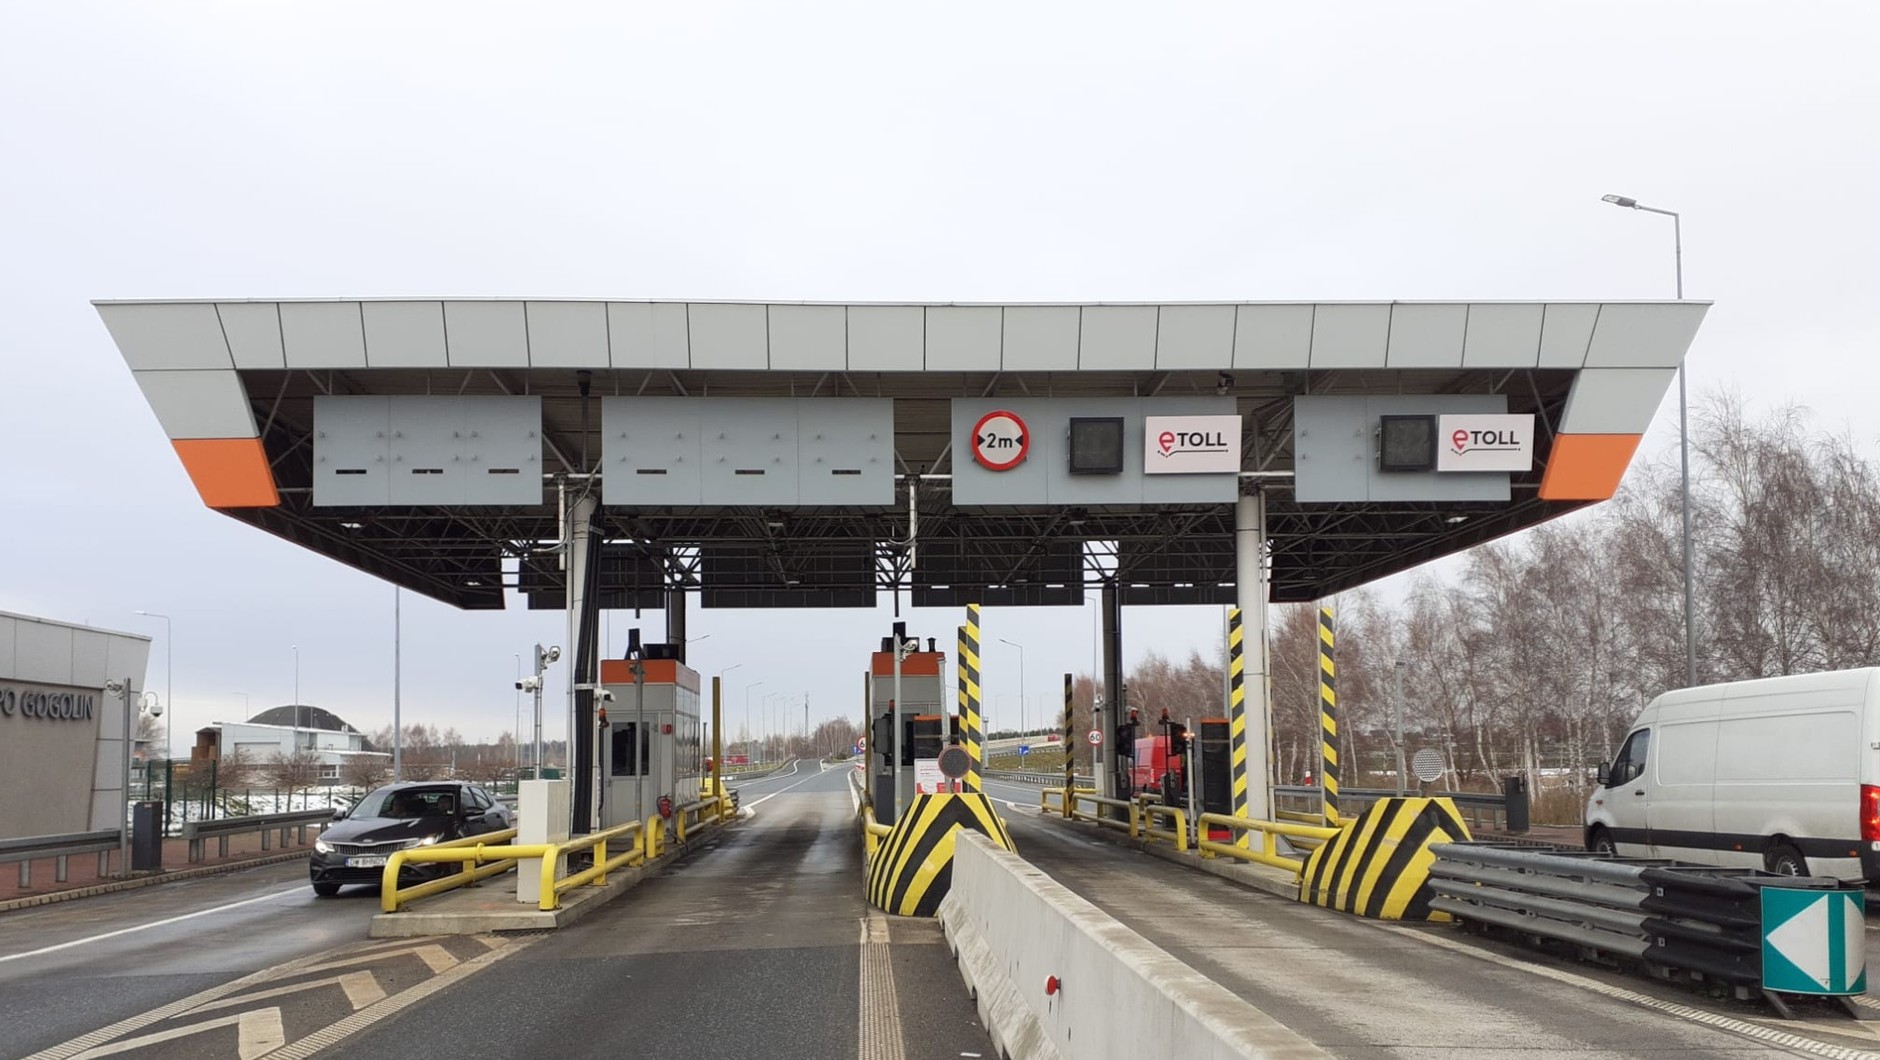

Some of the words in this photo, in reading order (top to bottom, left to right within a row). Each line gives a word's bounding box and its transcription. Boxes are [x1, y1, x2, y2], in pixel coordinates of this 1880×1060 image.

[0, 688, 16, 716] O
[21, 690, 94, 720] GOGOLIN
[1090, 733, 1101, 742] 60
